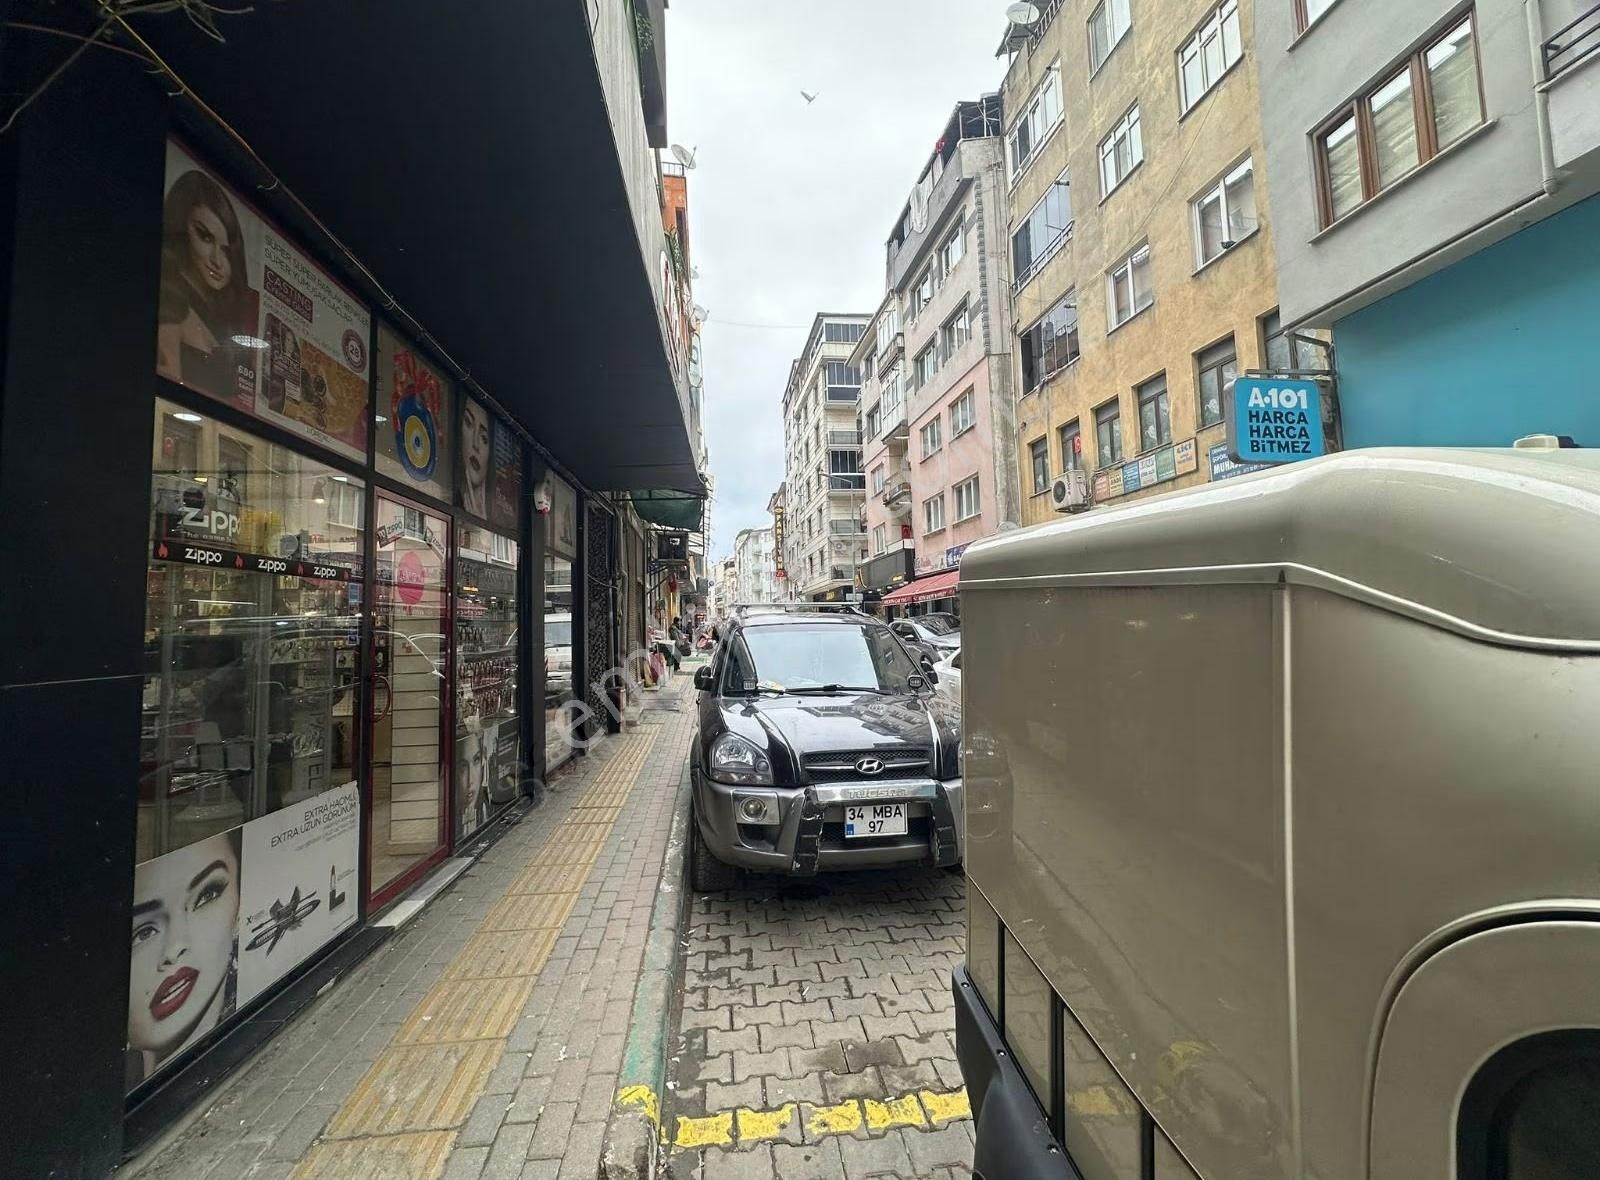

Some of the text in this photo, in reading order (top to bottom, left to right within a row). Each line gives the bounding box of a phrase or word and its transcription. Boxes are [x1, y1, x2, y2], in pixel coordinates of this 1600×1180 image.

[266, 270, 312, 312] CASTING
[1248, 410, 1309, 425] HARCA
[1249, 425, 1310, 440] HARCA
[304, 803, 328, 821] EXTRA
[847, 805, 903, 821] 34 MBA
[271, 828, 299, 848] EXTRA
[300, 817, 321, 834] UZUN
[868, 820, 884, 833] 97
